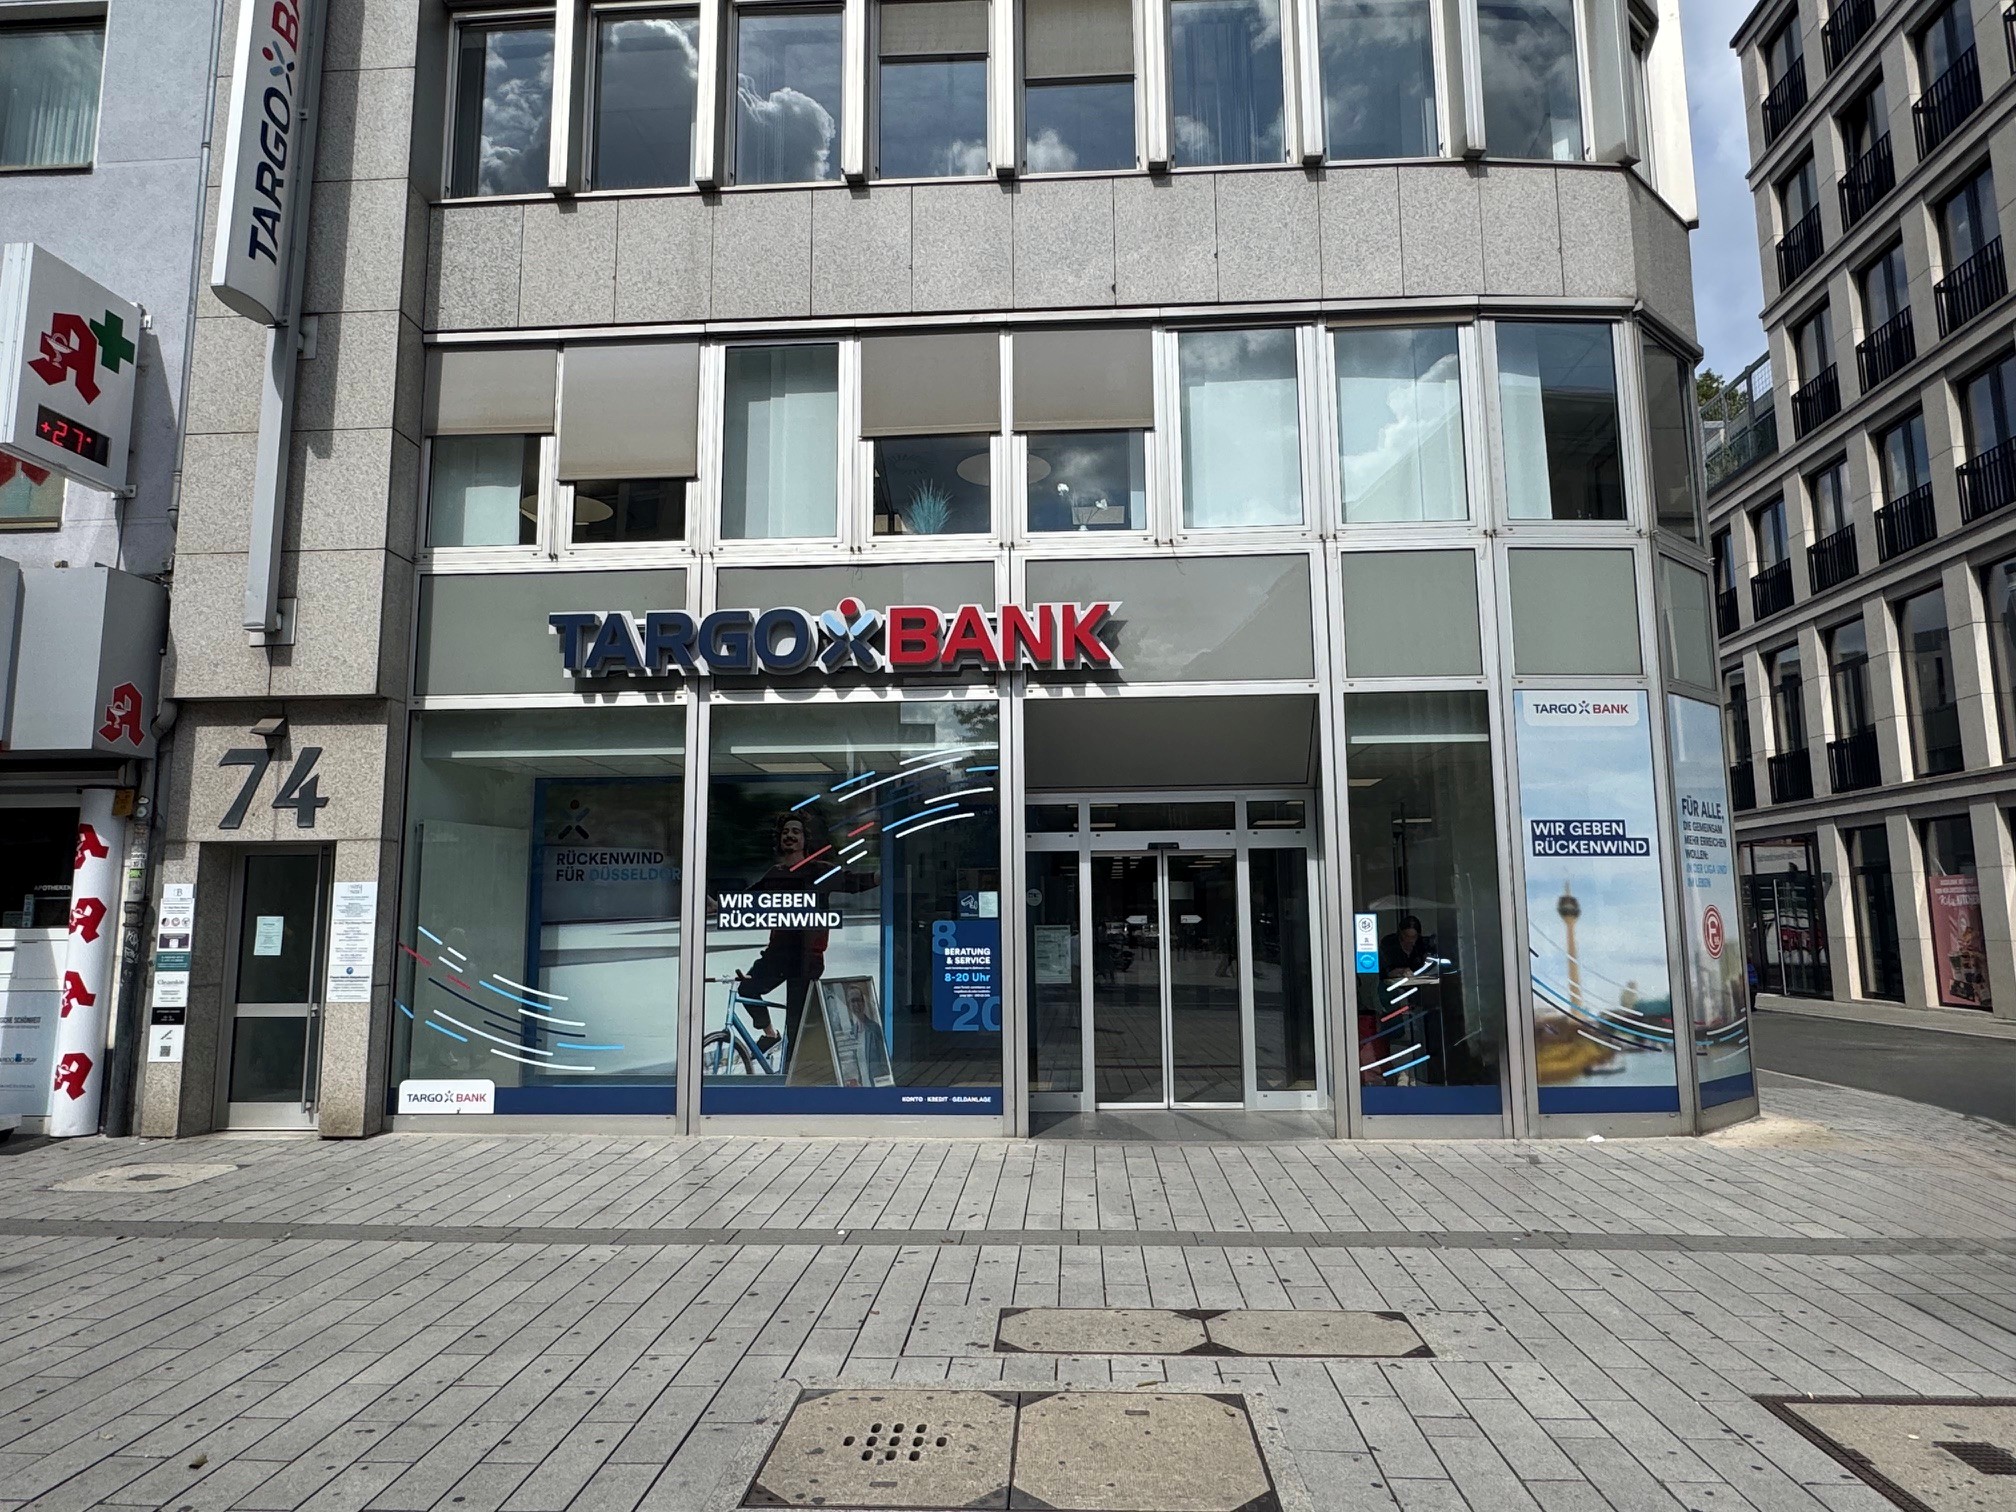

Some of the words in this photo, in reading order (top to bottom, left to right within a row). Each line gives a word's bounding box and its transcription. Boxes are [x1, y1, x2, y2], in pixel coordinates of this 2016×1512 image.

[248, 87, 291, 266] TARGO
[272, 0, 300, 54] B
[548, 608, 814, 677] TARGO
[887, 602, 1122, 672] BANK
[1533, 703, 1577, 714] TARGO
[1592, 704, 1629, 714] BANK
[218, 747, 330, 829] 74
[1682, 795, 1699, 817] FÜR
[1702, 801, 1724, 823] ALLE,
[1533, 822, 1565, 836] WIR
[1569, 822, 1623, 836] GEBEN
[1535, 838, 1647, 854] RÜCKENWIND
[556, 850, 664, 866] RÜCKENWIND
[556, 866, 585, 881] FÜR
[719, 893, 753, 908] WIR
[758, 893, 816, 908] GEBEN
[719, 910, 840, 928] RÜCKENWIND
[944, 948, 991, 956] BERATUNG
[946, 957, 953, 965] &
[955, 957, 991, 965] SERVICE
[944, 973, 969, 982] 8-20
[972, 972, 990, 982] Uhr
[407, 1093, 443, 1103] TARGO
[456, 1093, 487, 1103] BANK
